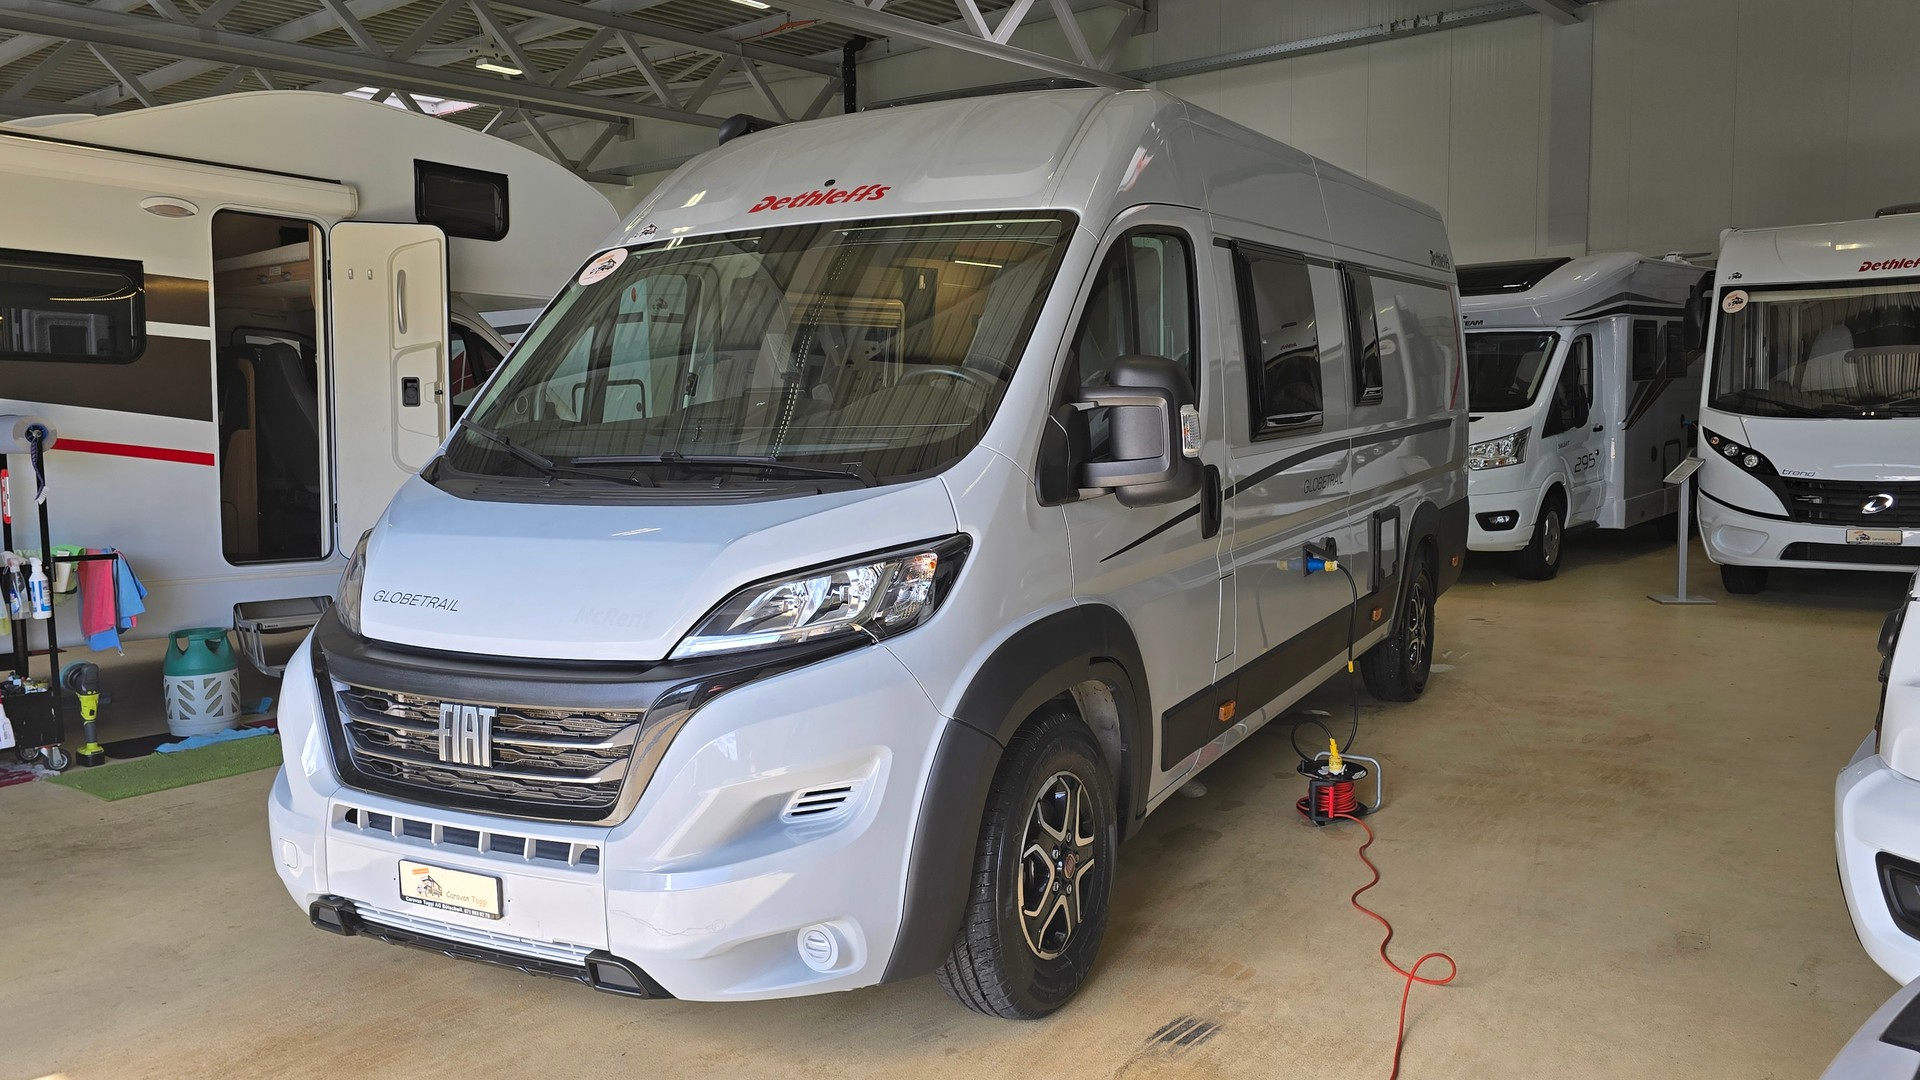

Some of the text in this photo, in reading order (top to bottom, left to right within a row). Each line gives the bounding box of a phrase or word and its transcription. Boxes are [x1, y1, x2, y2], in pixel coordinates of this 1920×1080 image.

[747, 184, 891, 213] Dethleffs
[1303, 472, 1344, 494] GLOBETRAL
[1782, 469, 1816, 477] trend
[373, 589, 459, 612] GLOBETRAIL
[438, 703, 497, 768] FIAT
[446, 890, 470, 902] Caravan
